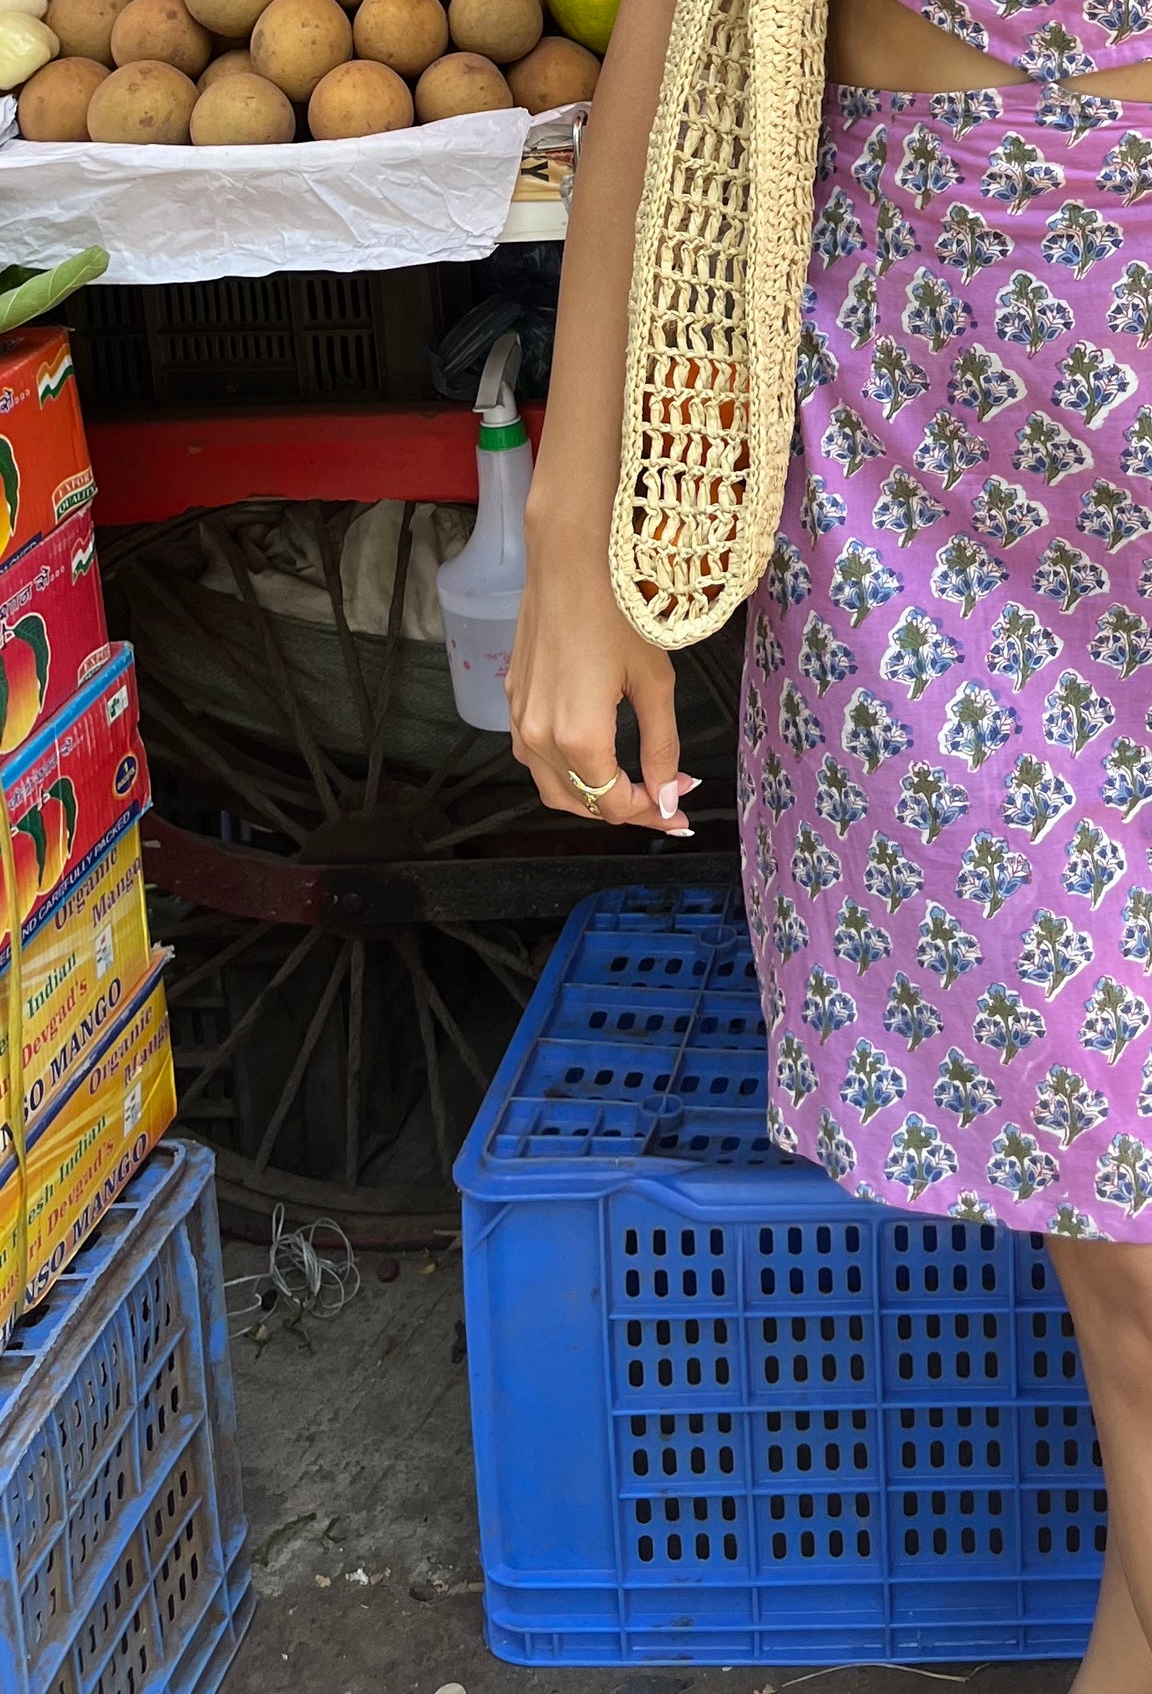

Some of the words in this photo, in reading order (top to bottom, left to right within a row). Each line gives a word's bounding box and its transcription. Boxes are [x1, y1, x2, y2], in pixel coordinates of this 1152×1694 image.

[22, 917, 37, 943] ND
[38, 853, 95, 915] CAREFULLY
[94, 811, 132, 859] PACKED
[54, 845, 118, 932] Organic
[91, 857, 142, 929] Mango
[22, 977, 88, 1070] Devgad's
[26, 950, 77, 1020] Indian
[50, 978, 122, 1087] MANGO
[88, 1005, 154, 1097] Organic
[46, 1138, 114, 1238] Devgad's
[58, 1114, 108, 1185] Indian
[72, 1132, 148, 1246] MANGO
